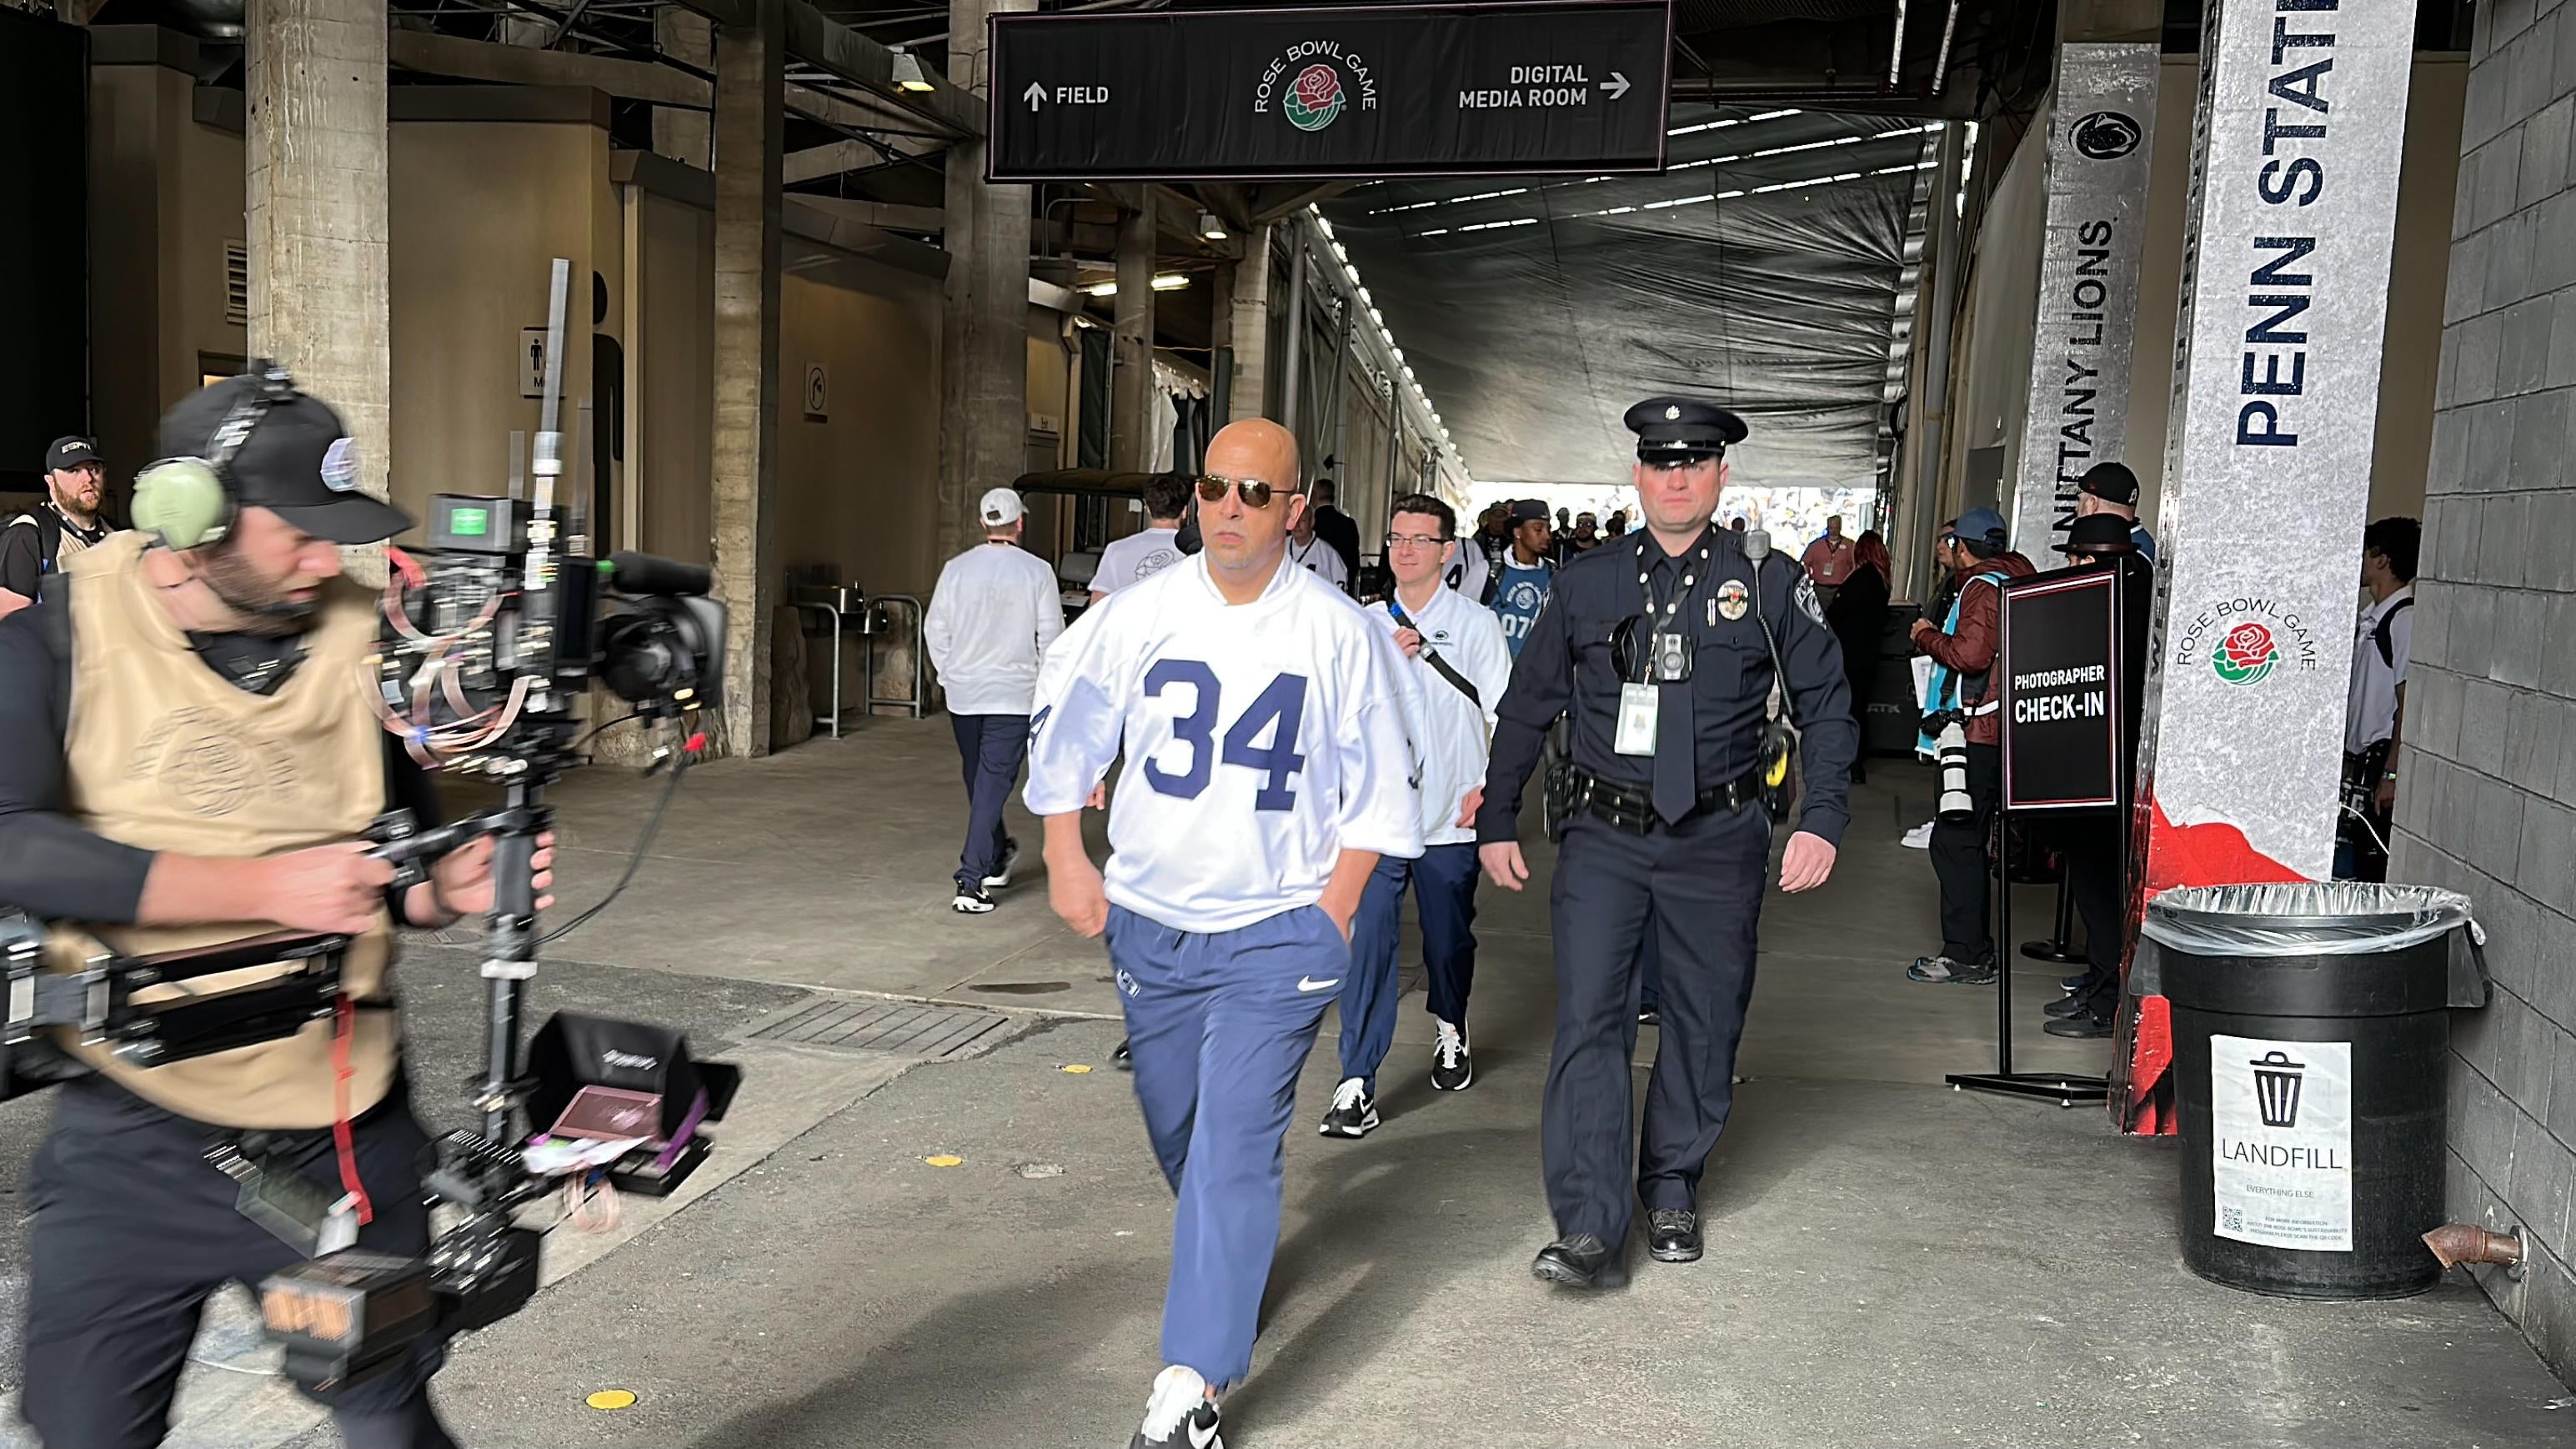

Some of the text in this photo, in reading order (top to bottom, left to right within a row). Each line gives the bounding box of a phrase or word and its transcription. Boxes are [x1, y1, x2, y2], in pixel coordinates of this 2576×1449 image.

[1255, 40, 1376, 113] ROSE BOWL GAME
[1511, 64, 1588, 83] DIGITAL
[1057, 87, 1109, 103] FIELD
[1459, 88, 1586, 108] MEDIA ROOM
[2236, 0, 2339, 447] PENN STAT
[2069, 219, 2112, 345] LIONS
[2178, 612, 2214, 665] ROSE
[2217, 597, 2280, 619] BOWL
[2284, 614, 2316, 670] GAME
[2015, 664, 2105, 690] PHOTOGRAPHER
[2015, 690, 2104, 724] CHECK-IN
[1144, 659, 1308, 812] 34
[2223, 1138, 2343, 1169] LANDFILL
[2246, 1185, 2293, 1197] EVERYTHING
